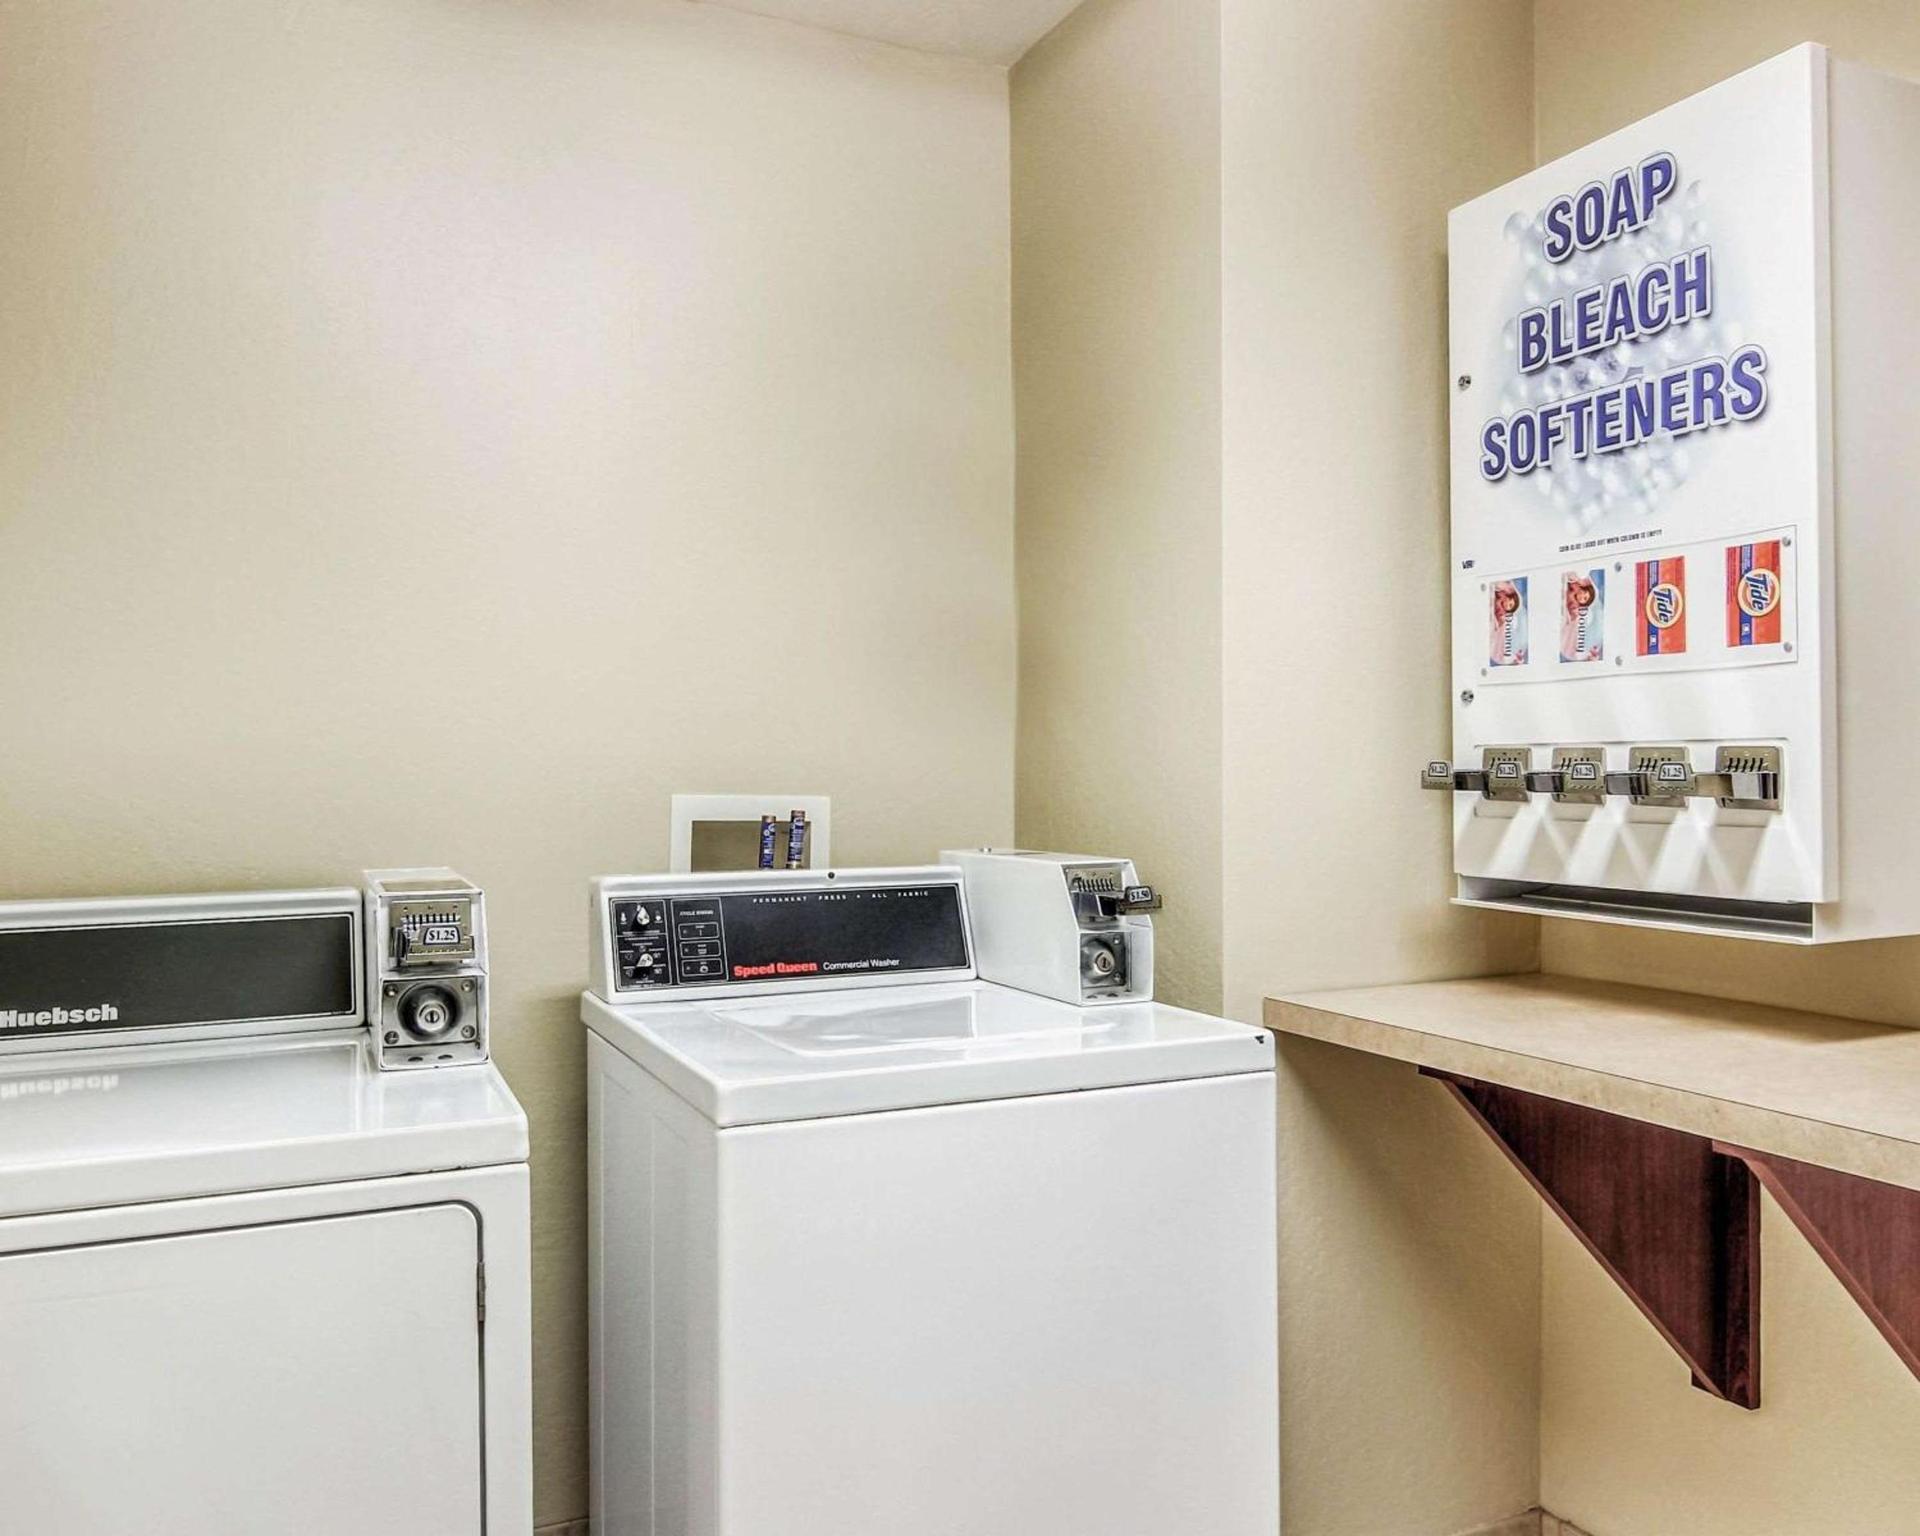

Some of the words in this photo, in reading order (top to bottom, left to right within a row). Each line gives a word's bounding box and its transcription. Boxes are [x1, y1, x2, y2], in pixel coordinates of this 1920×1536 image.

[1544, 151, 1678, 263] SOAP
[1517, 246, 1712, 373] BLEACH
[1480, 344, 1768, 480] SOFTENERS
[1746, 573, 1769, 611] Tide
[1653, 588, 1674, 623] Tide
[1574, 767, 1593, 777] $1.25
[1662, 767, 1683, 778] $1.25
[428, 929, 456, 941] $1.25
[733, 963, 775, 977] Speed
[776, 962, 818, 973] Queen
[823, 960, 870, 971] Commercial
[870, 958, 900, 968] Washer
[0, 1003, 119, 1029] Huebsch
